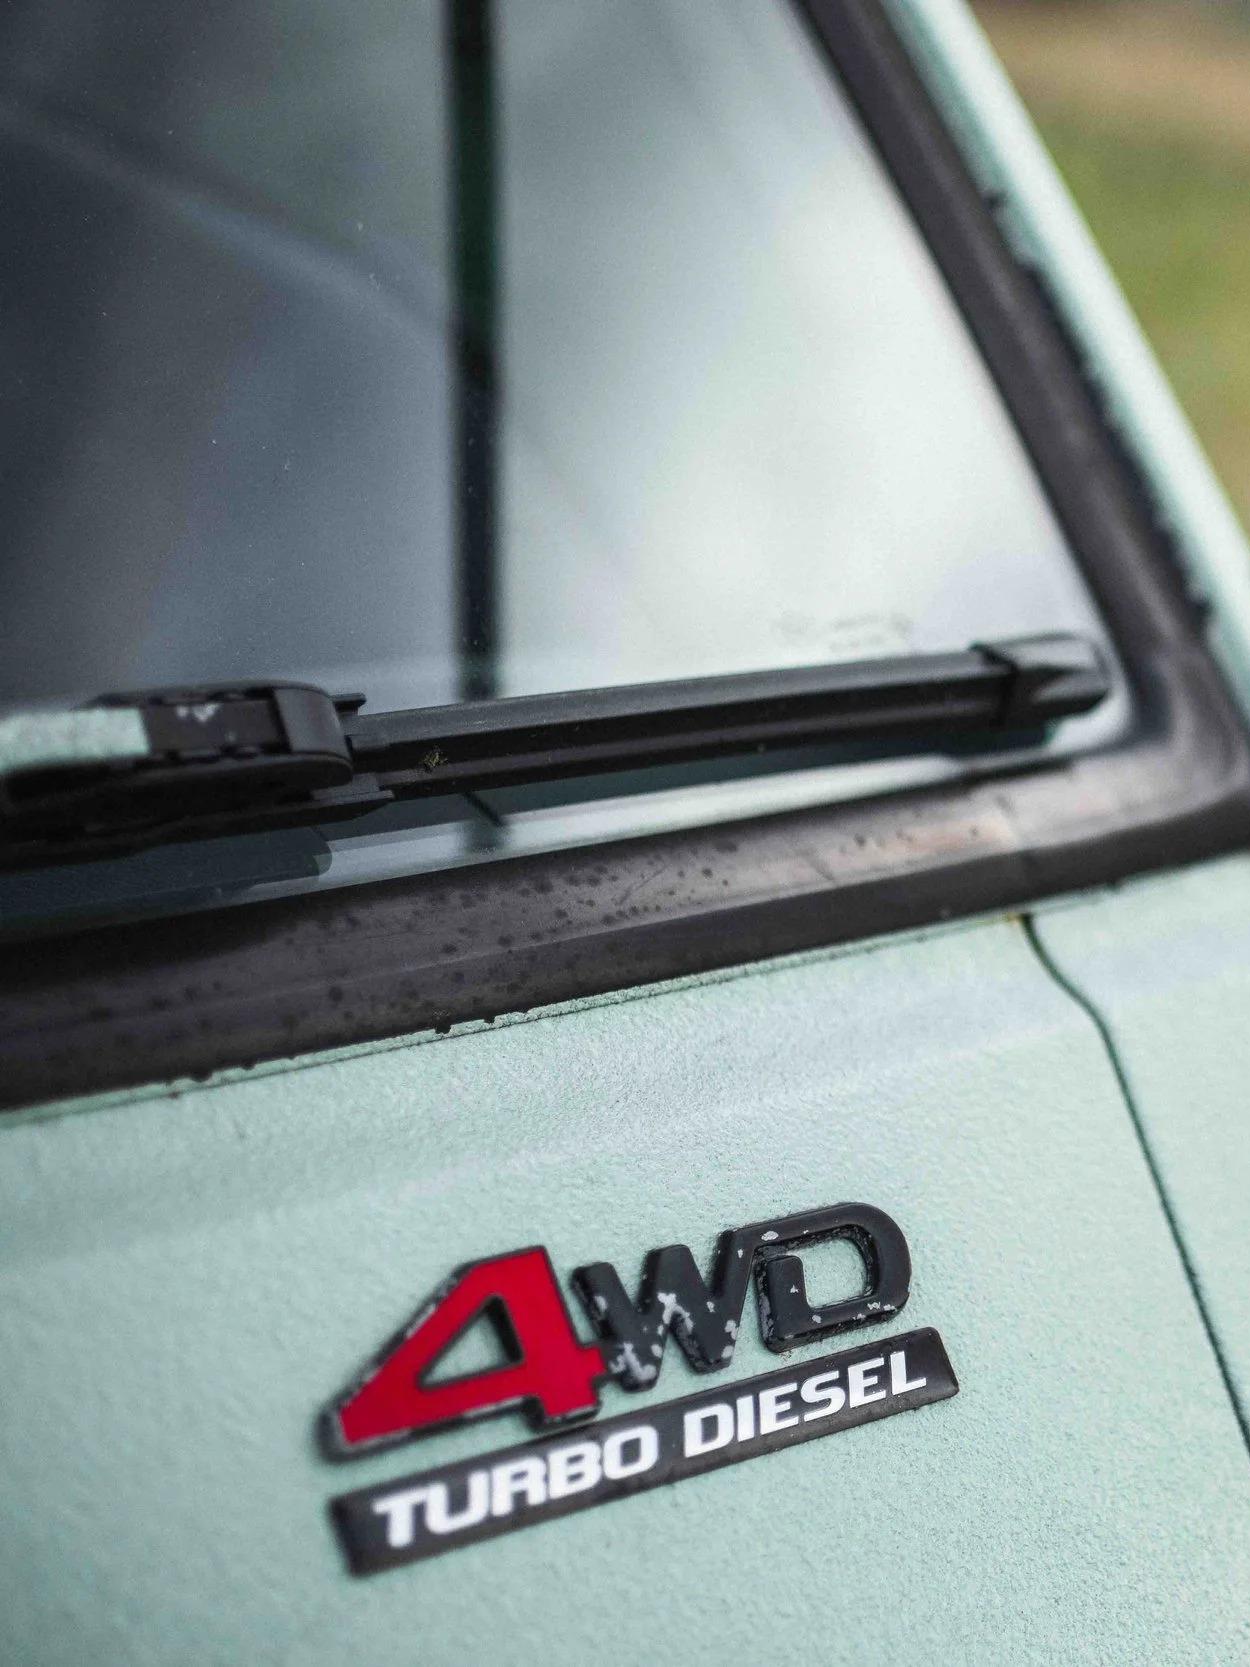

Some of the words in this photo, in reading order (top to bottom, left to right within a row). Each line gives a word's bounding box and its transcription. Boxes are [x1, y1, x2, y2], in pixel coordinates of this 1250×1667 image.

[319, 1202, 912, 1461] 4WD
[373, 1425, 659, 1548] TURBO
[683, 1350, 927, 1459] DIESEL
